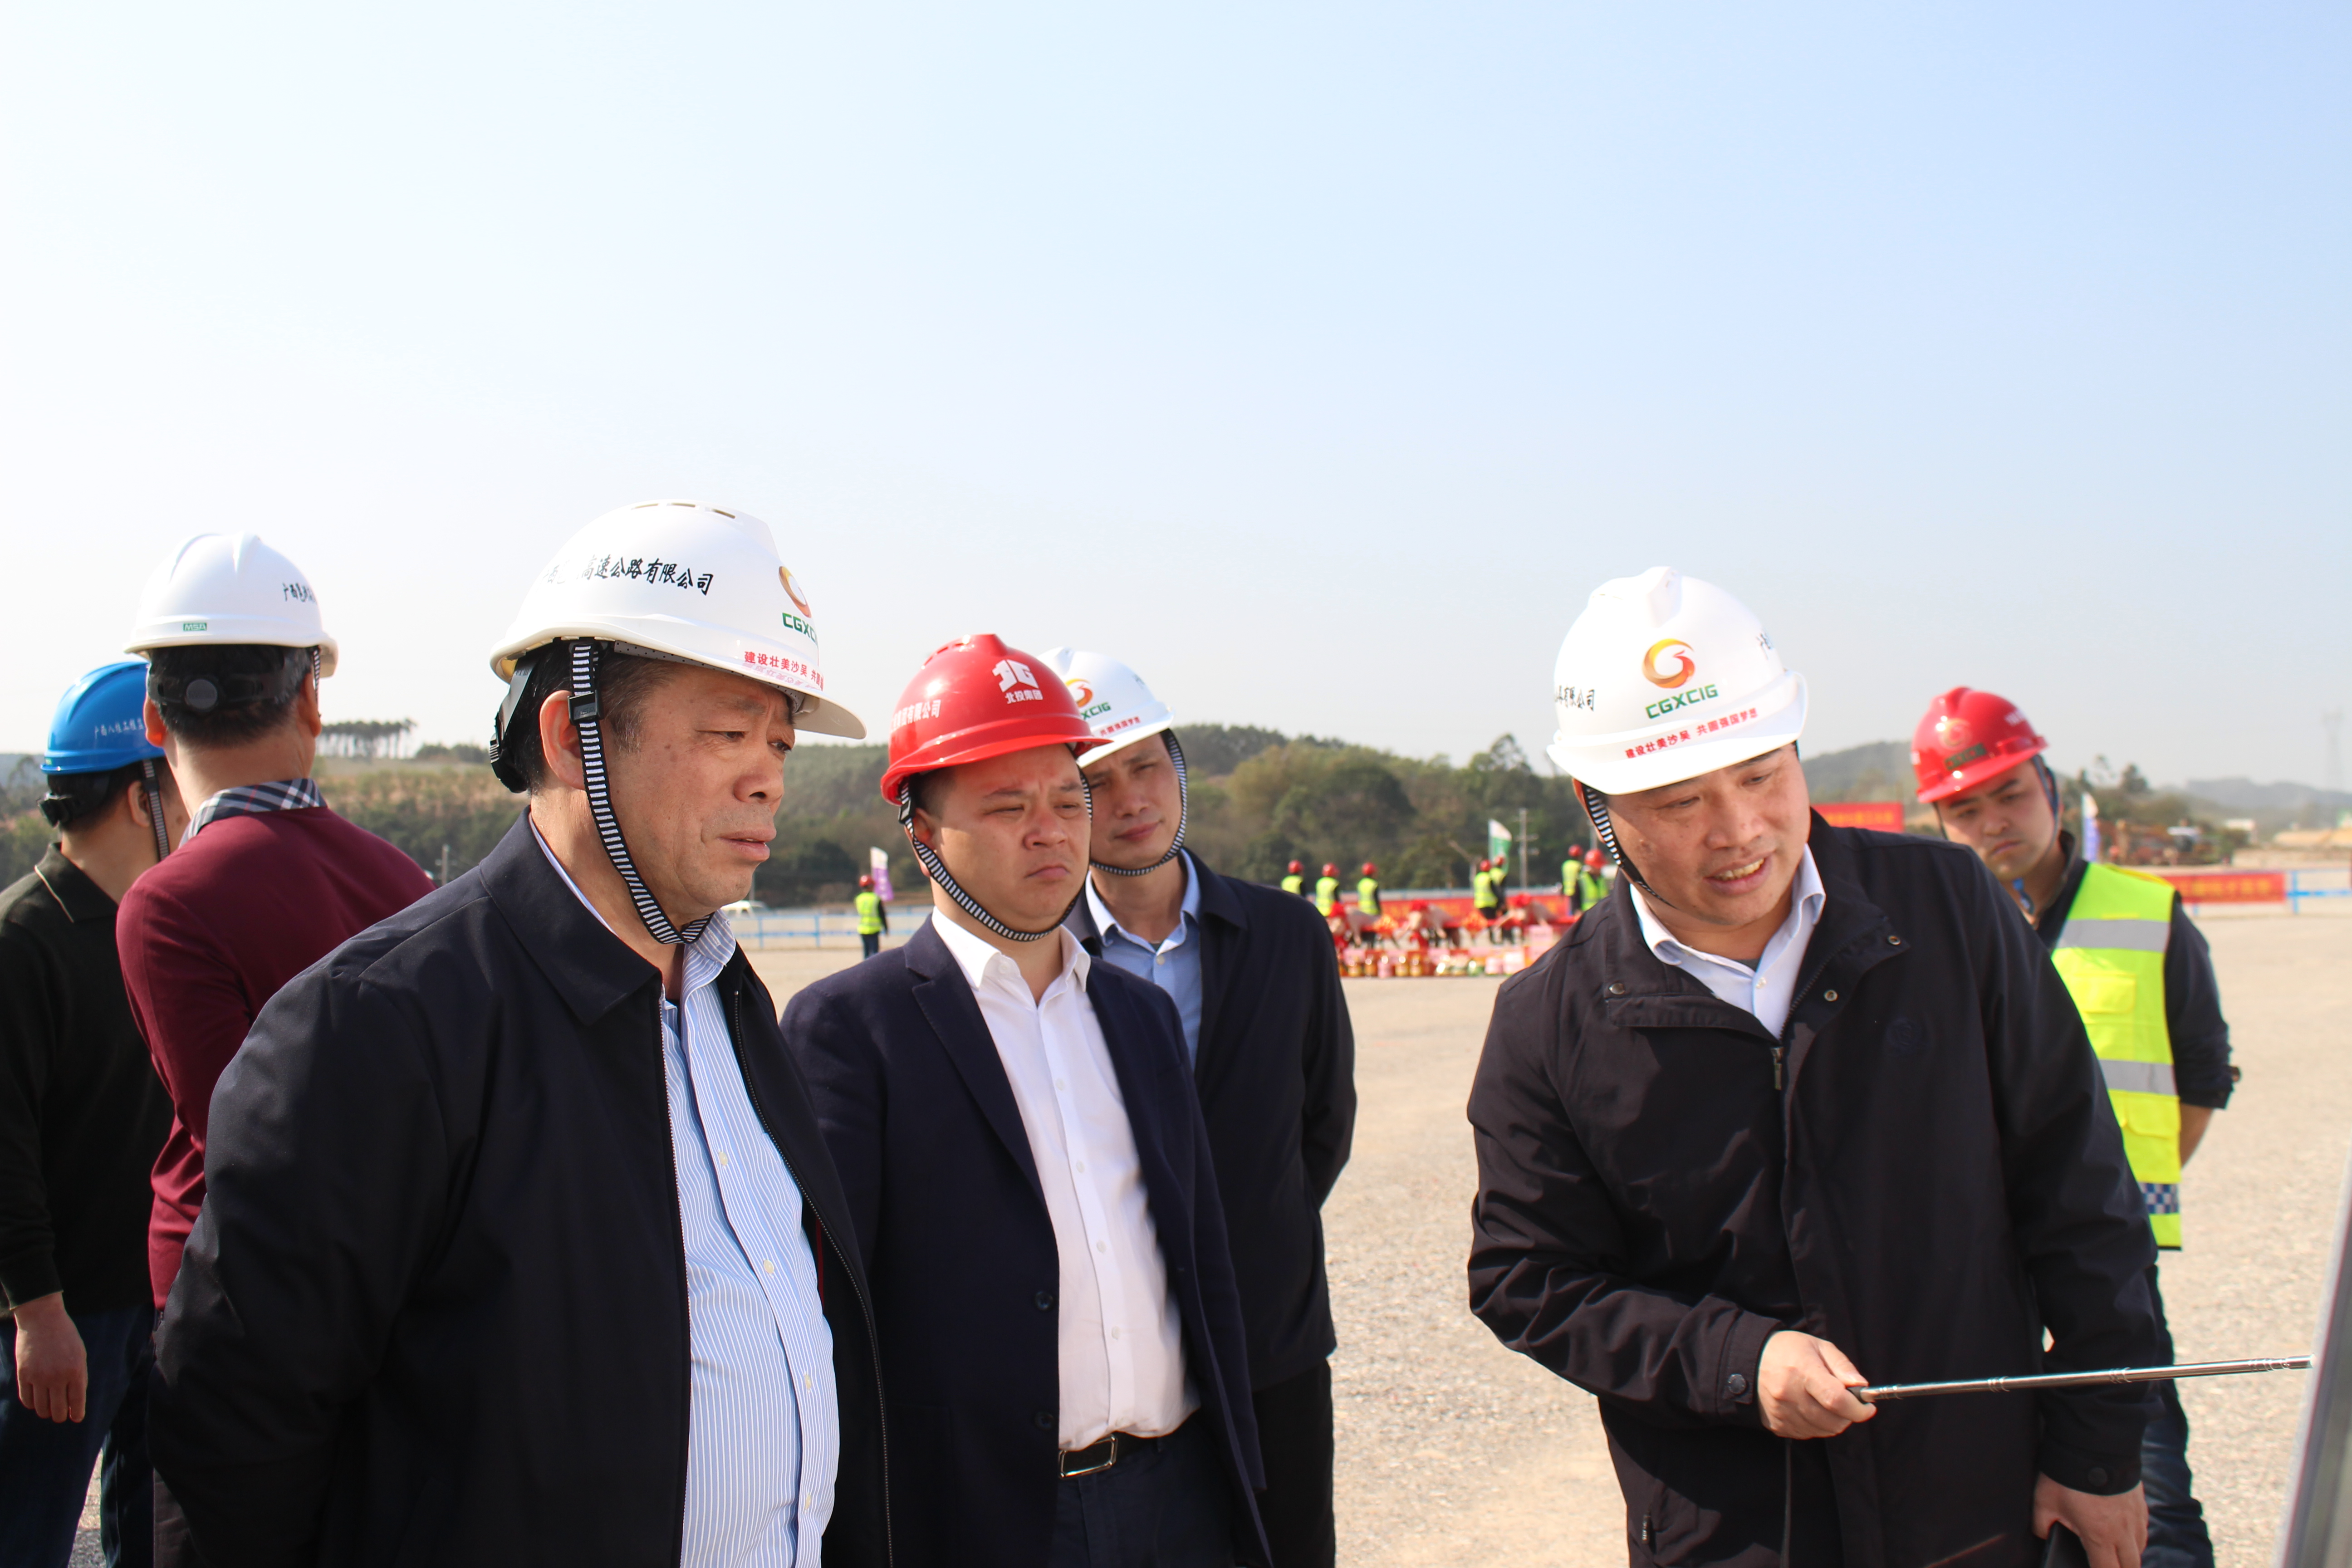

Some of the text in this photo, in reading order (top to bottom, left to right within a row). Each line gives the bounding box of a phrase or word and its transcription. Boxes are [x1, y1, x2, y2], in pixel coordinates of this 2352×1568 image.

[744, 651, 807, 677] 建设壮美沙吴
[1005, 689, 1044, 705] 北投集团
[1645, 684, 1719, 719] CGXCIG
[1625, 730, 1691, 759] 建设壮美沙吴
